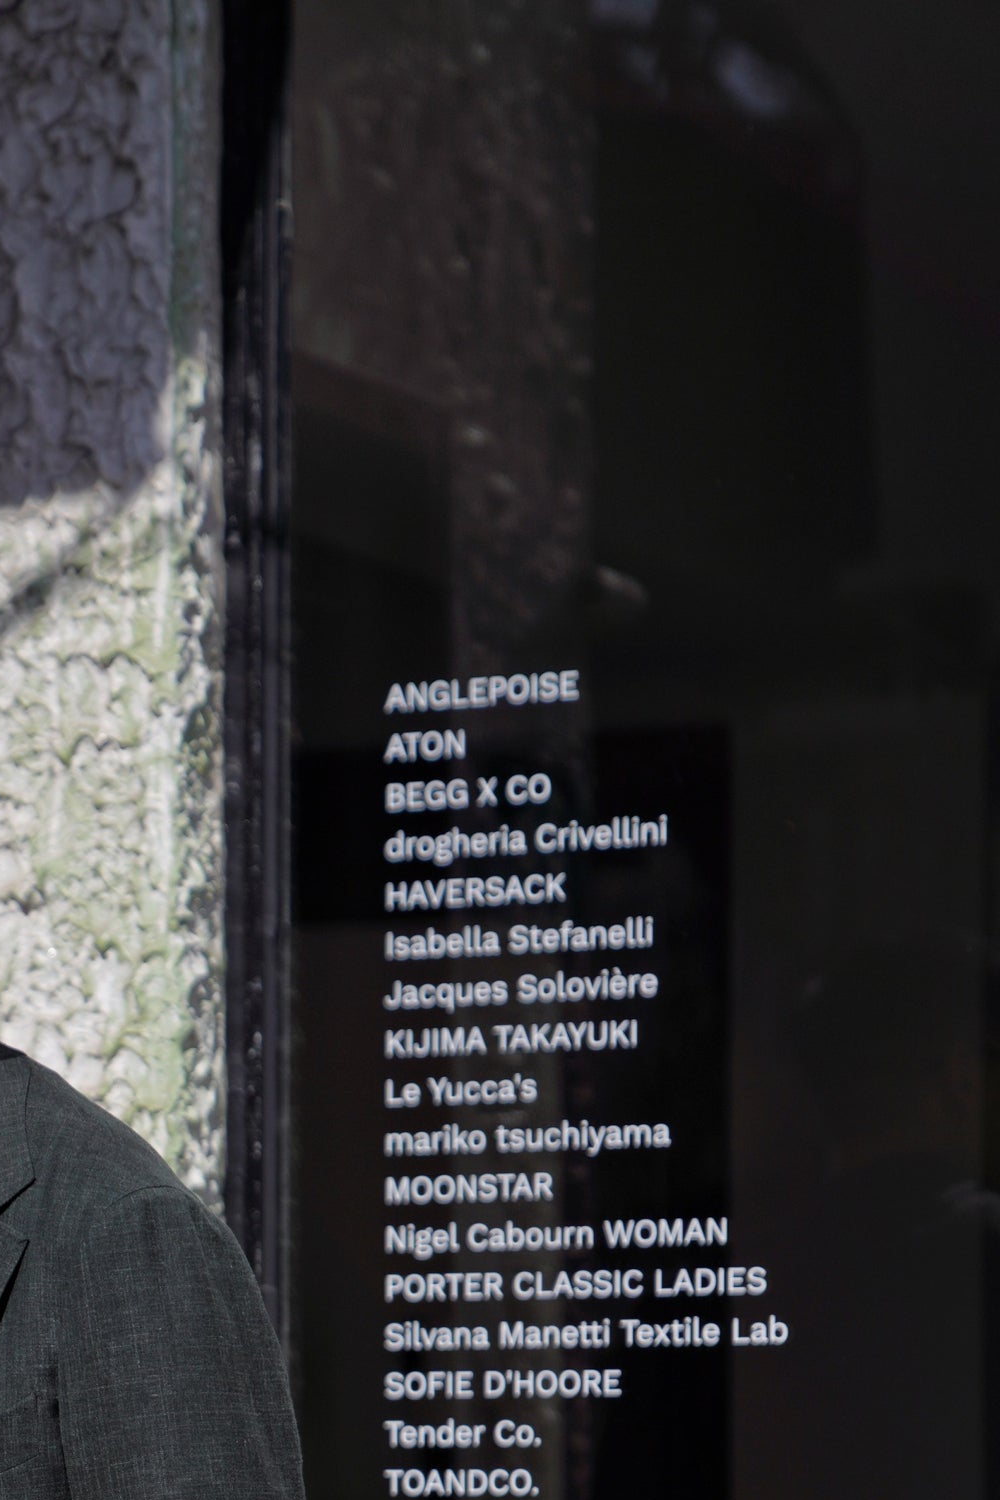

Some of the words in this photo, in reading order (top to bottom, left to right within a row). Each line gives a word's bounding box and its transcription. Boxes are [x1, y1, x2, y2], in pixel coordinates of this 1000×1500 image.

[383, 669, 580, 714] ANGLEPOISE
[383, 728, 467, 764] ATON
[385, 778, 469, 814] BEGG
[476, 776, 498, 808] X
[505, 772, 552, 805] CO
[384, 823, 528, 867] drogheria
[534, 814, 668, 854] Crivellini
[385, 871, 567, 912] HAVERSACK
[385, 924, 500, 961] Isabella
[507, 915, 654, 955] Stefanelli
[383, 979, 509, 1014] Jacques
[517, 966, 659, 1004] Solovière
[384, 1025, 488, 1059] KIJIMA
[492, 1018, 639, 1054] TAKAYUKI
[384, 1078, 422, 1109] Le
[427, 1072, 538, 1106] Yucca's
[384, 1122, 487, 1157] mariko
[494, 1119, 673, 1157] tsuchiyama
[384, 1171, 554, 1206] MOONSTAR
[384, 1222, 459, 1261] Nigel
[466, 1219, 595, 1252] Cabourn
[603, 1216, 729, 1248] WOMAN
[384, 1271, 504, 1304] PORTER
[512, 1268, 644, 1301] CLASSIC
[654, 1266, 768, 1297] LADIES
[384, 1320, 491, 1352] Silvana
[498, 1317, 611, 1350] Manetti
[619, 1315, 721, 1348] Textile
[731, 1314, 789, 1346] Lab
[384, 1370, 475, 1401] SOFIE
[483, 1368, 623, 1400] D'HOORE
[383, 1417, 486, 1449] Tender
[493, 1419, 542, 1448] Co.
[383, 1467, 540, 1497] TOANDCO.
